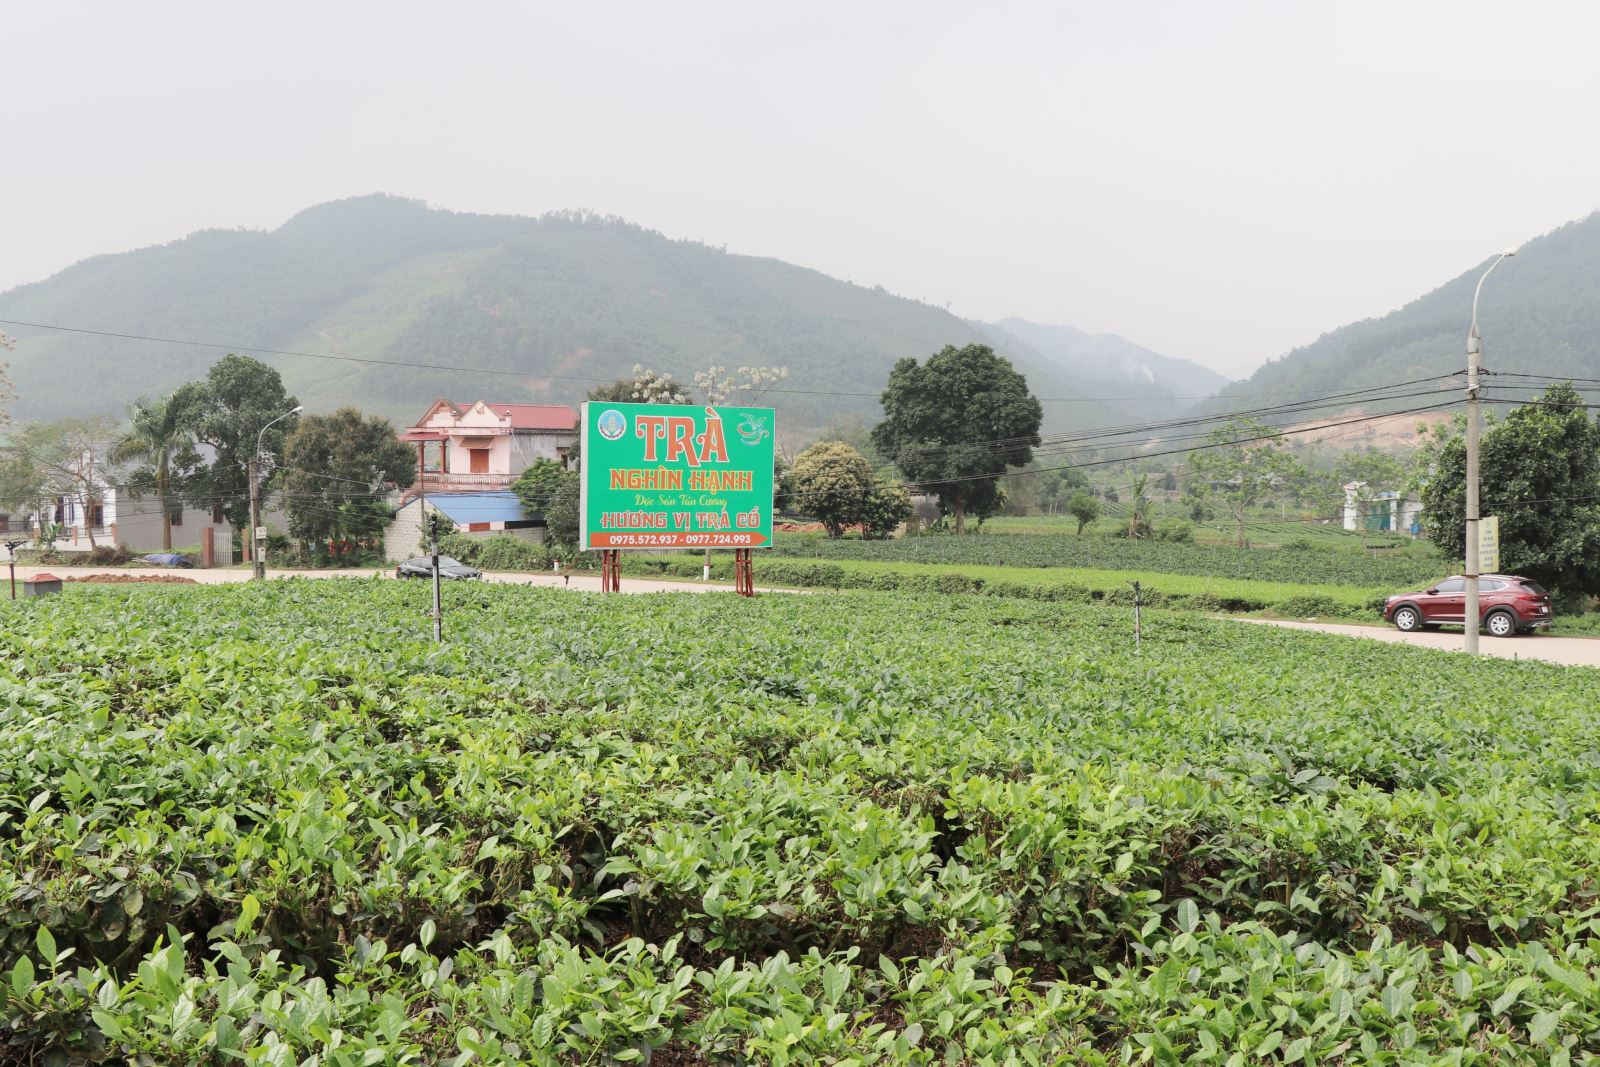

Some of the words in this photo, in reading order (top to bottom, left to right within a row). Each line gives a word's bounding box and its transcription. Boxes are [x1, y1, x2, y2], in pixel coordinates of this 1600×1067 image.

[635, 407, 729, 467] TRÀ
[609, 465, 683, 491] NGHÌN
[688, 470, 753, 495] HẠNH
[600, 509, 667, 529] HƯƠNG
[672, 511, 691, 531] VỊ
[695, 508, 730, 530] TRÀ
[609, 535, 678, 545] 0975.572.937
[686, 534, 751, 544] 0977.724.993
